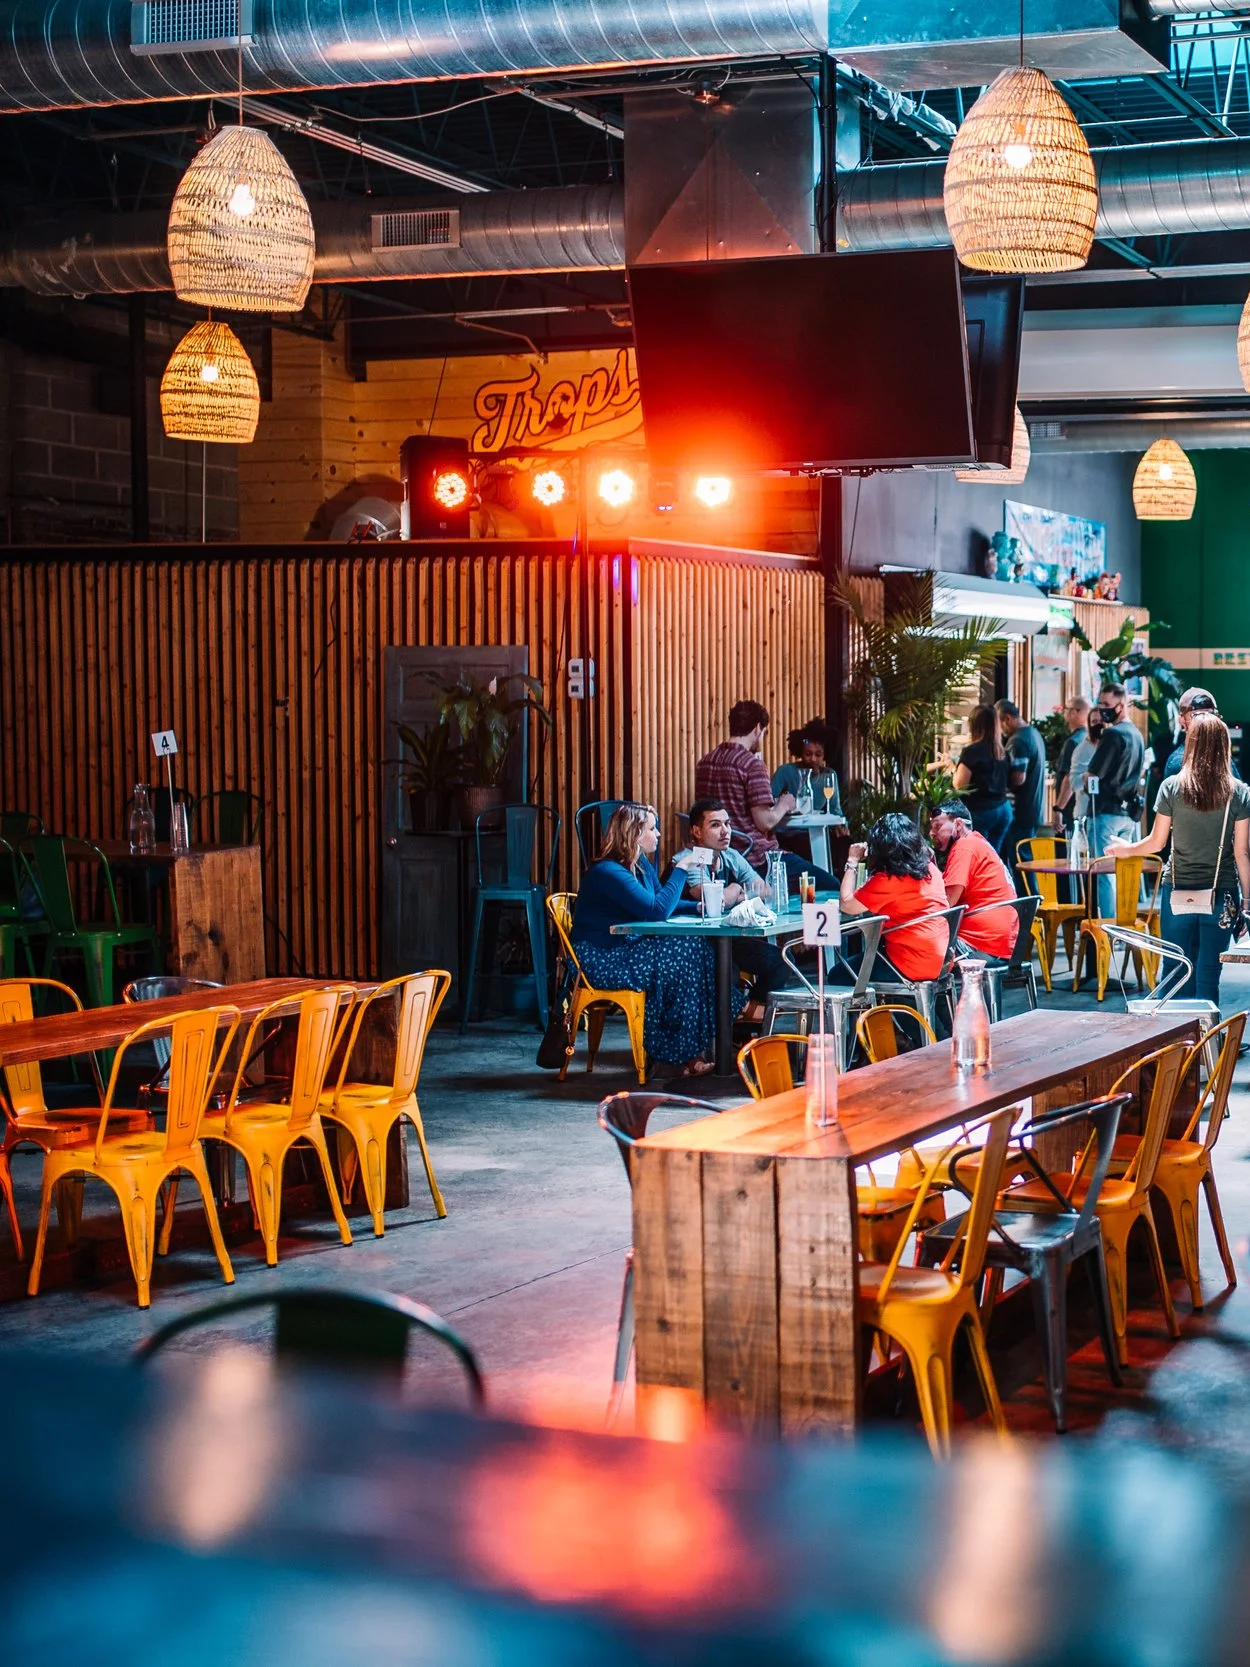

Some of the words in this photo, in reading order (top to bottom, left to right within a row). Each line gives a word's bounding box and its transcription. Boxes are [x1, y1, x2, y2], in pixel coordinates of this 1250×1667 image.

[473, 348, 641, 453] Trops
[161, 735, 170, 748] 4
[816, 911, 828, 937] 2
